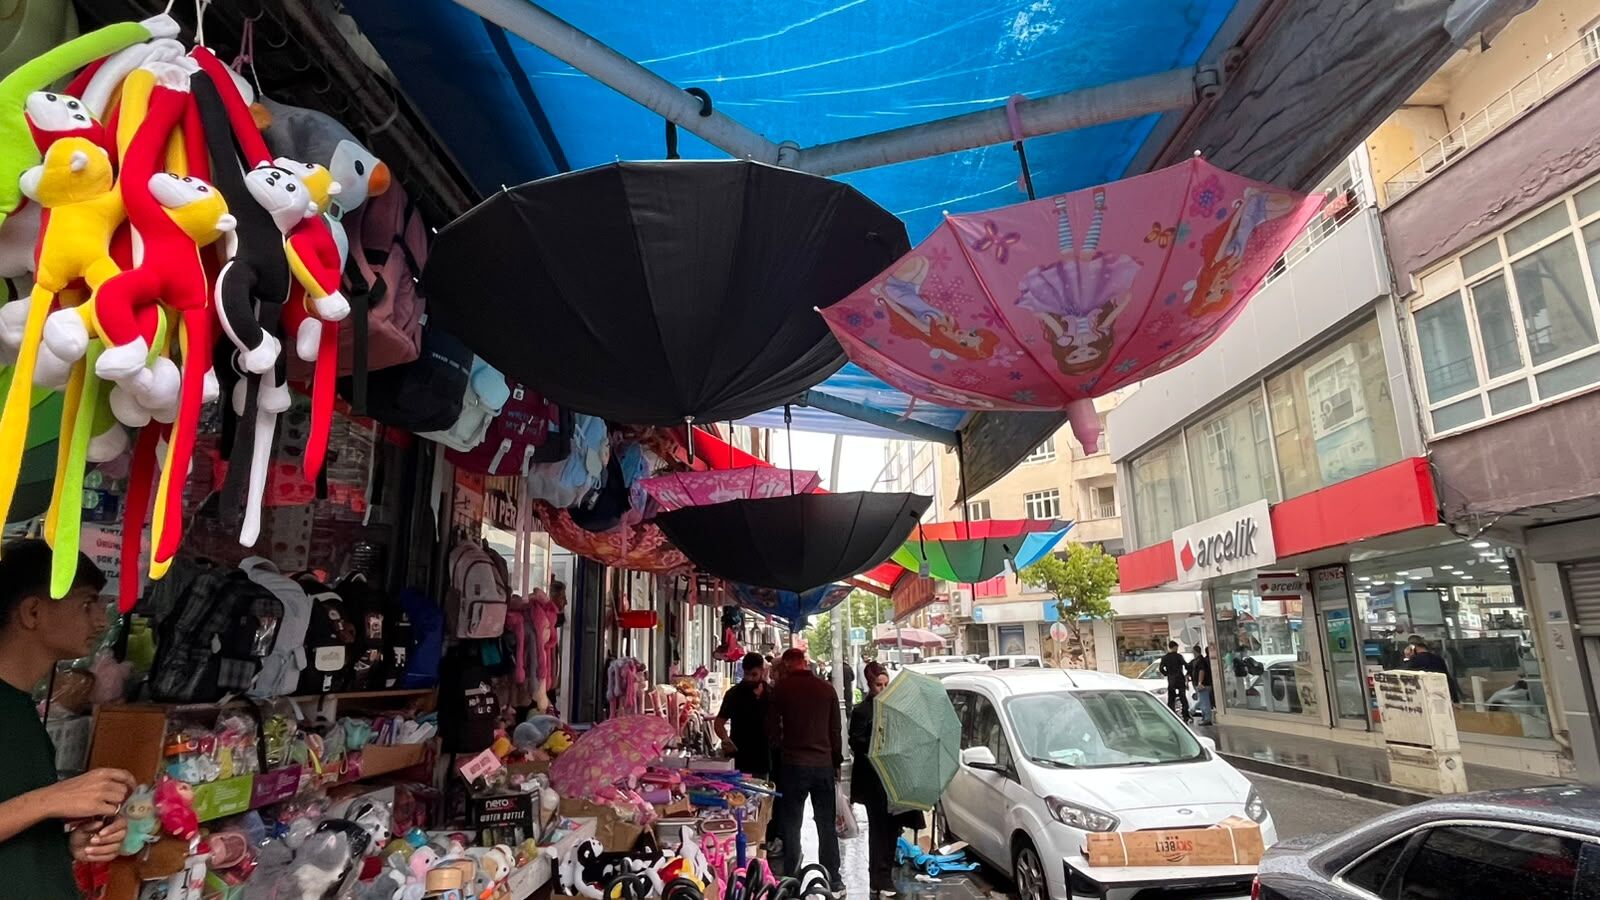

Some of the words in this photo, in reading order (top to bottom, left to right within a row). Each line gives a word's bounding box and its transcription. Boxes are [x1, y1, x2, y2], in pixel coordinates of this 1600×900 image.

[1197, 517, 1257, 572] arçelik
[502, 810, 525, 821] BOTTLE
[1155, 840, 1193, 853] SKYBELT
